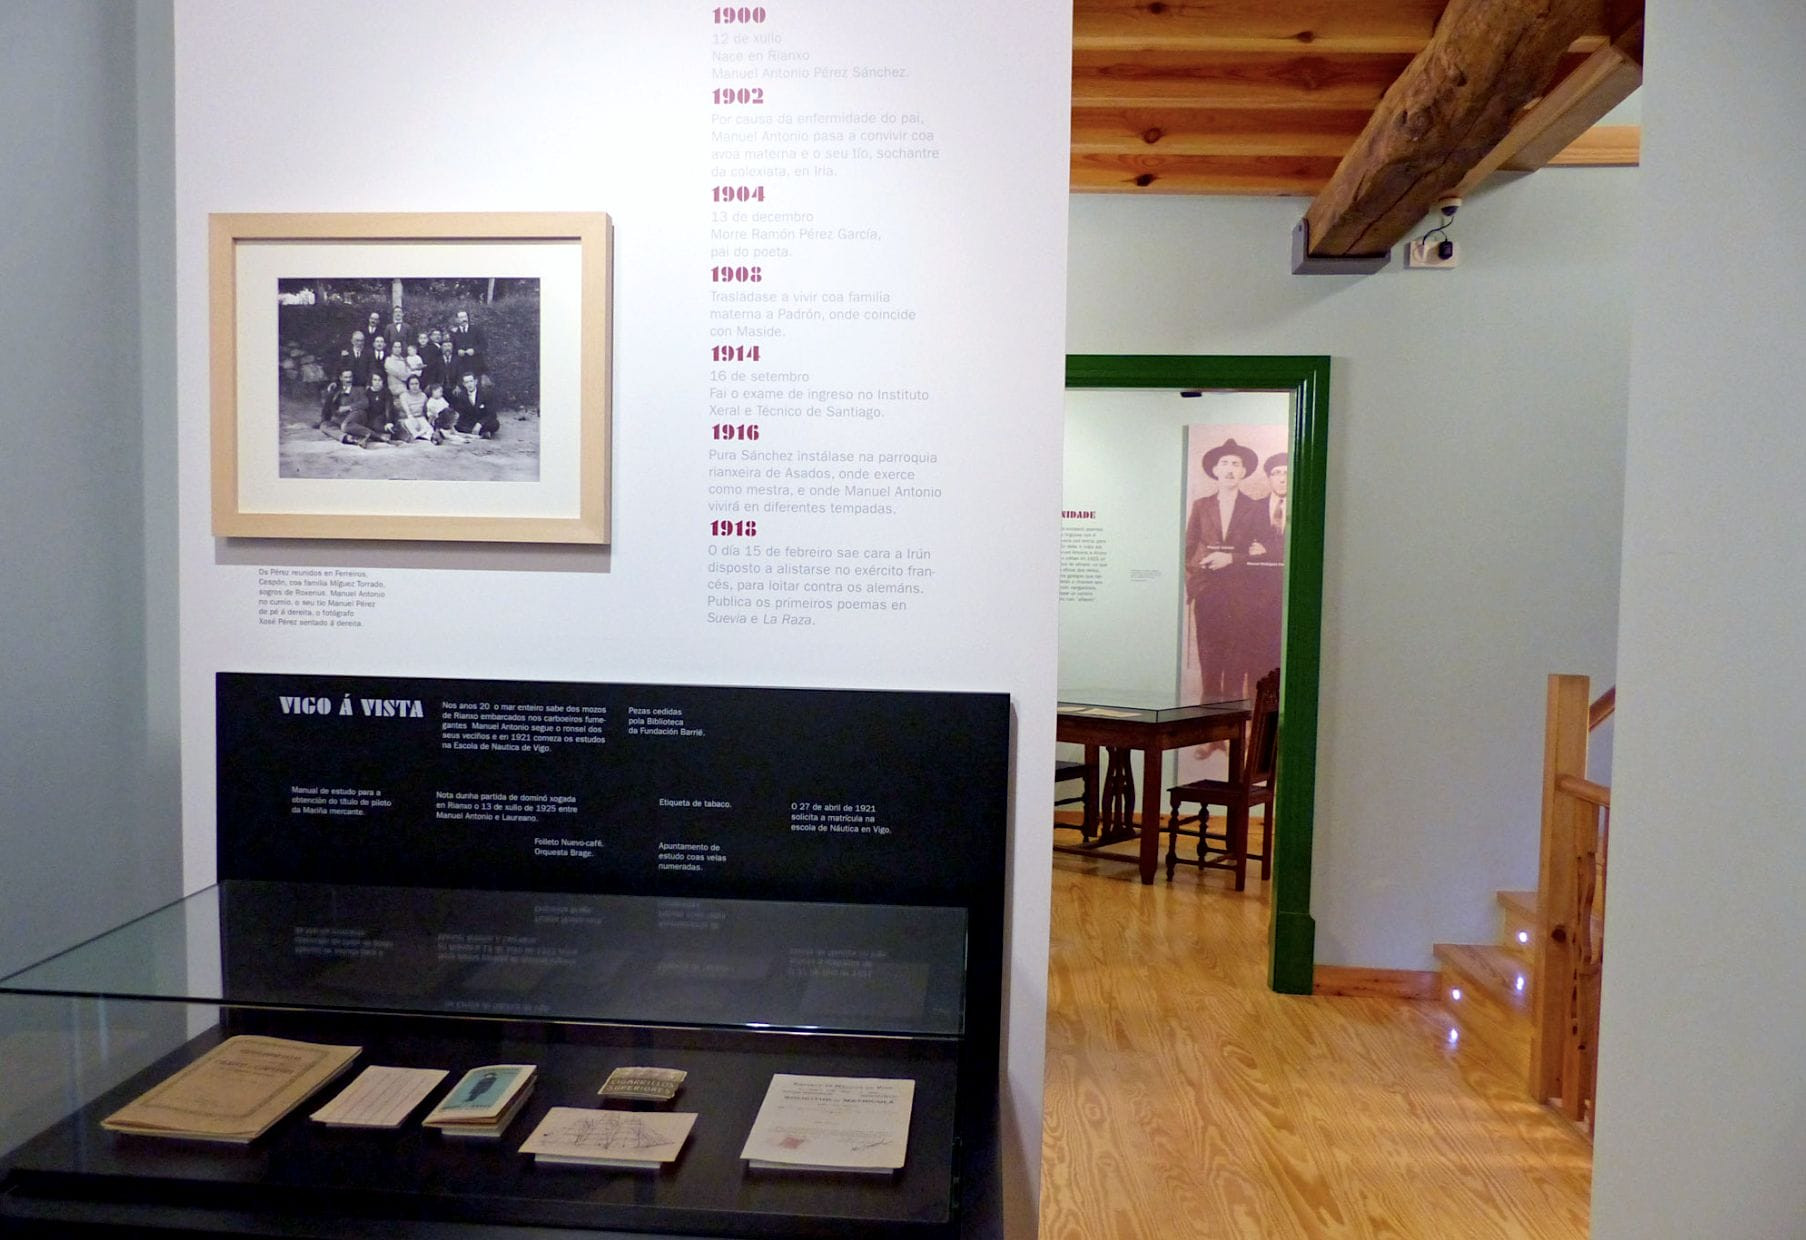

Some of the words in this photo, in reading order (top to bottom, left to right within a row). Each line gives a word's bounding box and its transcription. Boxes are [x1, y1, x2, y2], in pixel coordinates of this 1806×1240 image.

[713, 7, 766, 23] 1900
[713, 88, 764, 104] 1902
[712, 186, 765, 202] 1904
[711, 266, 762, 282] 1908
[782, 293, 789, 301] a
[793, 291, 817, 301] vivir
[822, 293, 844, 301] coa
[848, 291, 892, 302] familia
[710, 308, 761, 319] materna
[766, 310, 773, 319] a
[829, 309, 860, 319] onde
[863, 309, 916, 319] coincide
[710, 327, 732, 336] con
[711, 345, 760, 361] 1914
[709, 370, 727, 381] 16
[731, 370, 746, 381] de
[751, 371, 809, 381] setembro
[710, 387, 726, 398] Fai
[731, 390, 739, 398] o
[743, 390, 783, 398] exame
[788, 388, 803, 398] de
[808, 390, 853, 402] ingreso
[858, 391, 873, 399] no
[878, 389, 929, 399] Instituto
[709, 405, 740, 415] Xeral
[745, 407, 752, 415] e
[806, 405, 821, 416] de
[826, 406, 884, 419] Santiago.
[712, 424, 760, 440] 1916
[708, 449, 736, 459] Pura
[739, 449, 792, 460] Sánchez
[859, 453, 874, 461] na
[878, 454, 937, 464] parroquia
[709, 466, 761, 477] rianxeira
[765, 467, 780, 477] de
[838, 468, 869, 478] onde
[874, 471, 915, 479] exerce
[708, 486, 742, 494] como
[746, 484, 793, 495] mestra,
[797, 487, 805, 495] e
[809, 485, 841, 495] onde
[845, 485, 890, 496] Manuel
[895, 486, 943, 496] Antonio
[708, 500, 739, 511] vivirá
[744, 503, 759, 511] en
[763, 501, 826, 512] diferentes
[710, 520, 757, 536] 1918
[708, 544, 717, 555] O
[721, 545, 740, 555] día
[745, 545, 762, 555] 15
[765, 546, 780, 556] de
[785, 546, 833, 557] febreiro
[837, 549, 859, 557] sae
[863, 550, 890, 558] cara
[895, 550, 902, 558] a
[708, 563, 760, 574] disposto
[765, 565, 772, 573] a
[776, 563, 832, 574] alistarse
[835, 566, 850, 574] no
[908, 565, 935, 575] fran-
[707, 579, 732, 589] cés,
[737, 582, 764, 592] para
[769, 580, 799, 590] loitar
[804, 581, 844, 591] contra
[847, 584, 862, 592] os
[866, 582, 923, 593] alemáns.
[707, 595, 751, 606] Publica
[756, 599, 770, 607] os
[837, 601, 887, 611] poemas
[891, 601, 906, 609] en
[750, 615, 758, 623] e
[763, 613, 777, 623] La
[782, 614, 815, 624] Raza.
[279, 696, 331, 714] VIGO
[339, 693, 352, 715] Á
[360, 699, 423, 717] VISTA
[647, 717, 683, 725] Biblioteca
[659, 798, 690, 806] Etiqueta
[799, 802, 810, 810] 27
